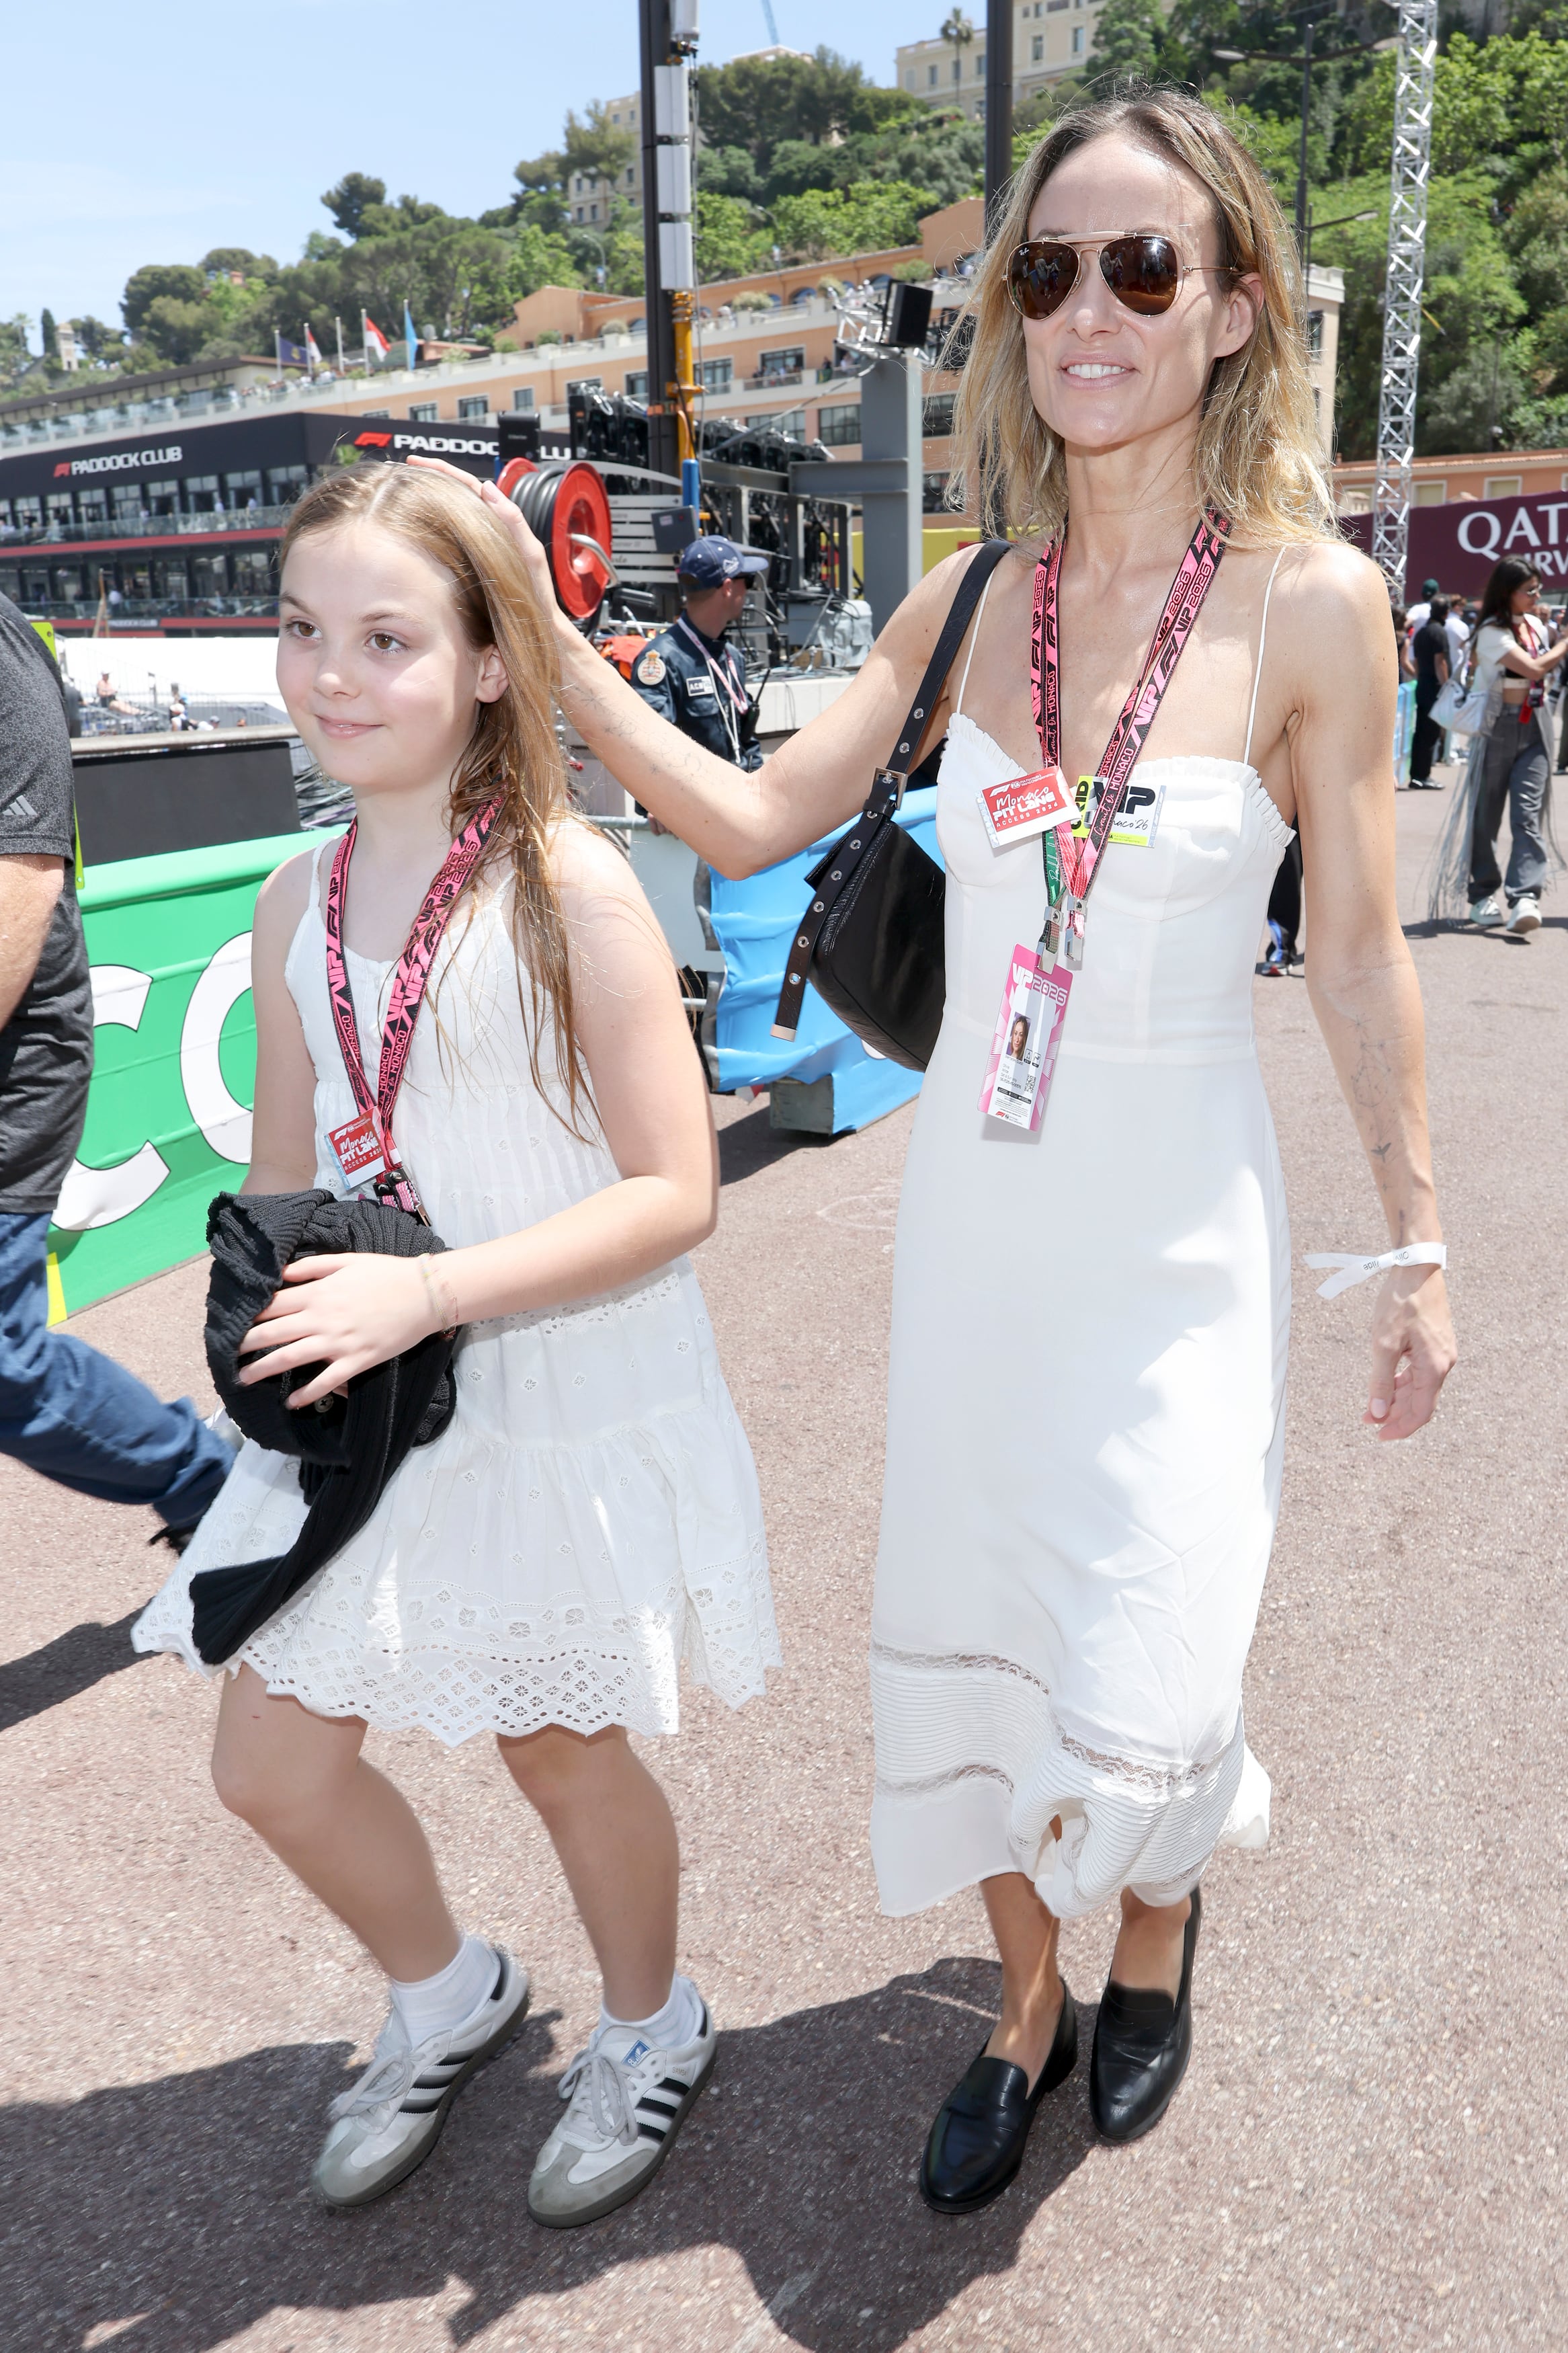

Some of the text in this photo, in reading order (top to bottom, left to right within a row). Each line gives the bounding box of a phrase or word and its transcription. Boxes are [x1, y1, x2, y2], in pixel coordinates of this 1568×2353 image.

[71, 452, 140, 475] PADDOCK
[141, 446, 183, 466] CLUB
[394, 434, 500, 456] PADDOC
[1457, 502, 1568, 561] QAT
[1034, 570, 1045, 610] 2026
[1168, 570, 1192, 616] 2026
[1175, 606, 1193, 632] VIP
[1189, 562, 1212, 608] 2026
[1032, 610, 1042, 635] VIP
[1047, 670, 1056, 714] MONACO
[1110, 748, 1134, 791] MONACO
[993, 805, 1016, 822] PIT
[996, 787, 1050, 811] Monaco
[996, 802, 1058, 828] ACCESS 2026
[1012, 963, 1068, 1006] VIP 2026
[380, 1046, 391, 1090] MONACO
[390, 1030, 407, 1073] MONACO
[339, 1149, 357, 1165] PIT
[344, 1156, 367, 1170] ACCESS
